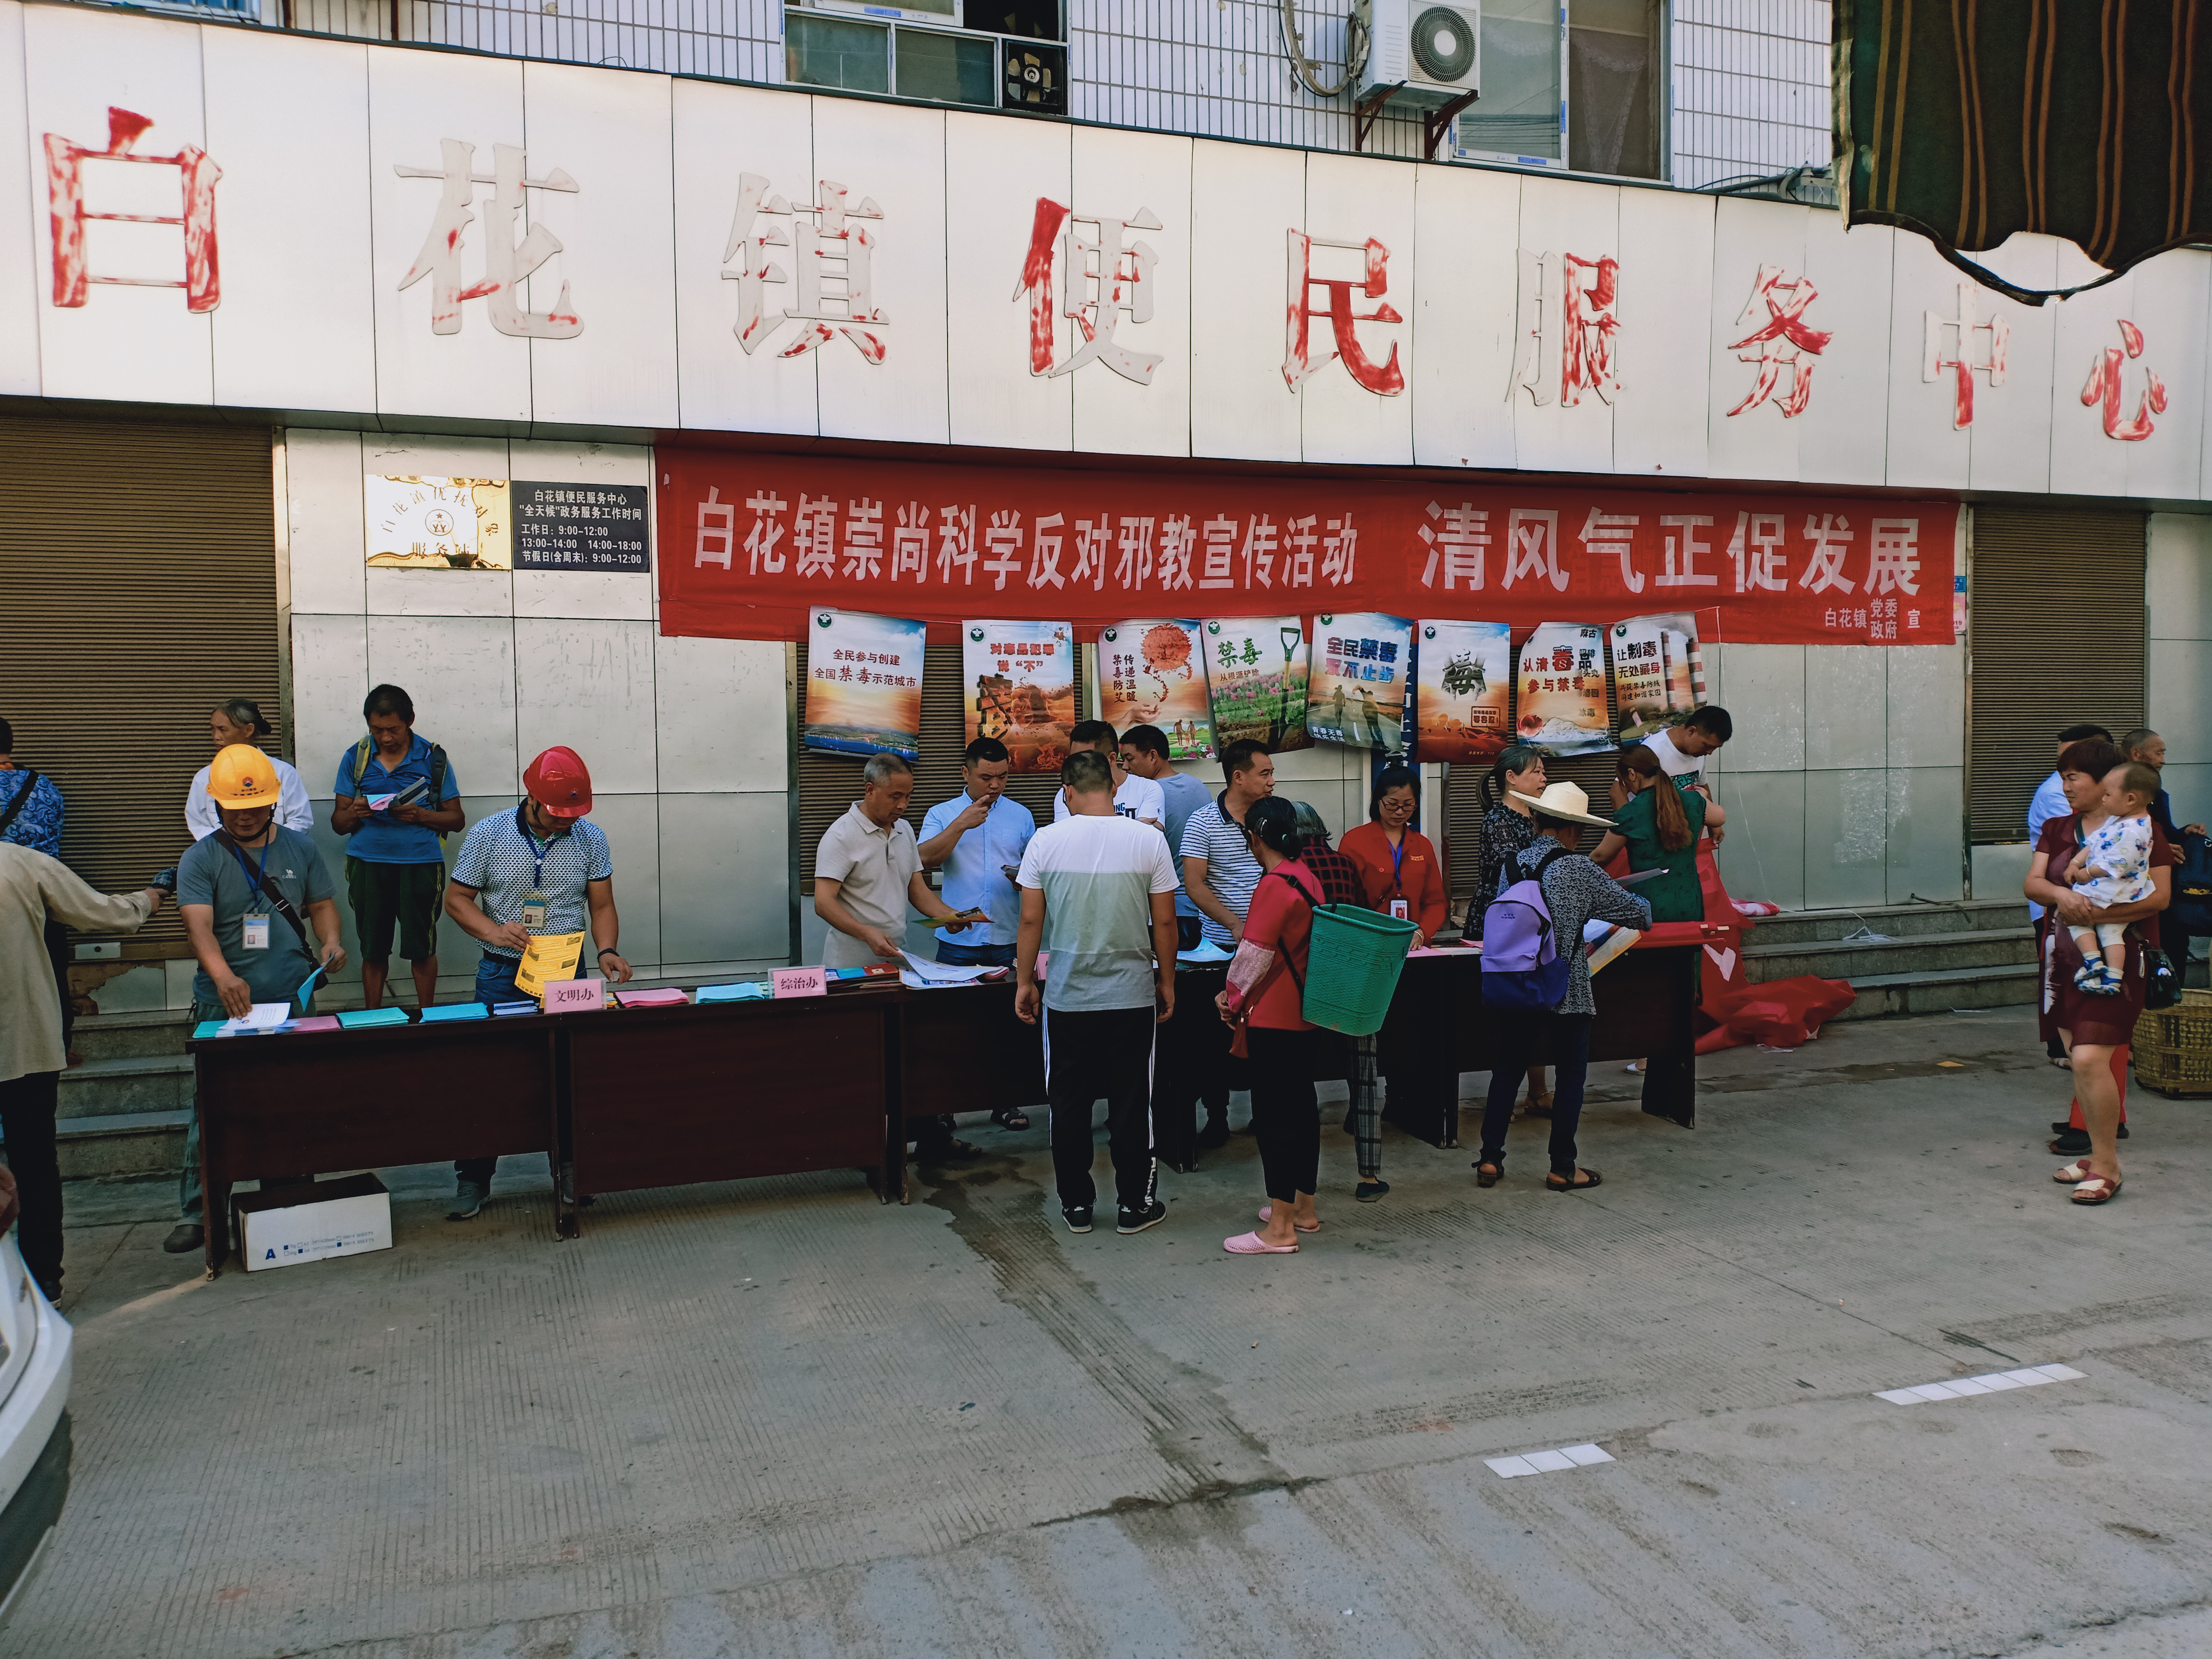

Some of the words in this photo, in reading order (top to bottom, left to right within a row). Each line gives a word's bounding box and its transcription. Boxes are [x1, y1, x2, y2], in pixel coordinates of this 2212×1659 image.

[43, 106, 2168, 442] 白花镇便民服务中心
[534, 489, 627, 505] 白花镇便民服务中心
[694, 487, 1358, 591] 白花镇崇尚科学反对邪教宣传活动
[1417, 500, 1921, 596] 清风气正促发展
[1825, 607, 1867, 628] 白花镇
[1870, 598, 1897, 618] 党委
[1907, 609, 1920, 628] 宣
[1870, 620, 1897, 639] 政府
[833, 649, 901, 666] 全民参与创建
[1217, 637, 1262, 668] 禁毒
[1326, 637, 1398, 663] 全民禁毒
[1617, 641, 1657, 661] 让制毒
[814, 665, 917, 687] 全国禁毒示范城市
[1112, 654, 1125, 703] 禁毒防艾
[1123, 654, 1138, 702] 传递温暖
[1220, 669, 1260, 682] 从根源铲除
[1618, 661, 1661, 678] 无处藏身
[1527, 676, 1585, 694] 参与禁毒
[1113, 802, 1125, 812] NG
[781, 976, 818, 990] 综治办
[554, 988, 594, 1003] 文明办
